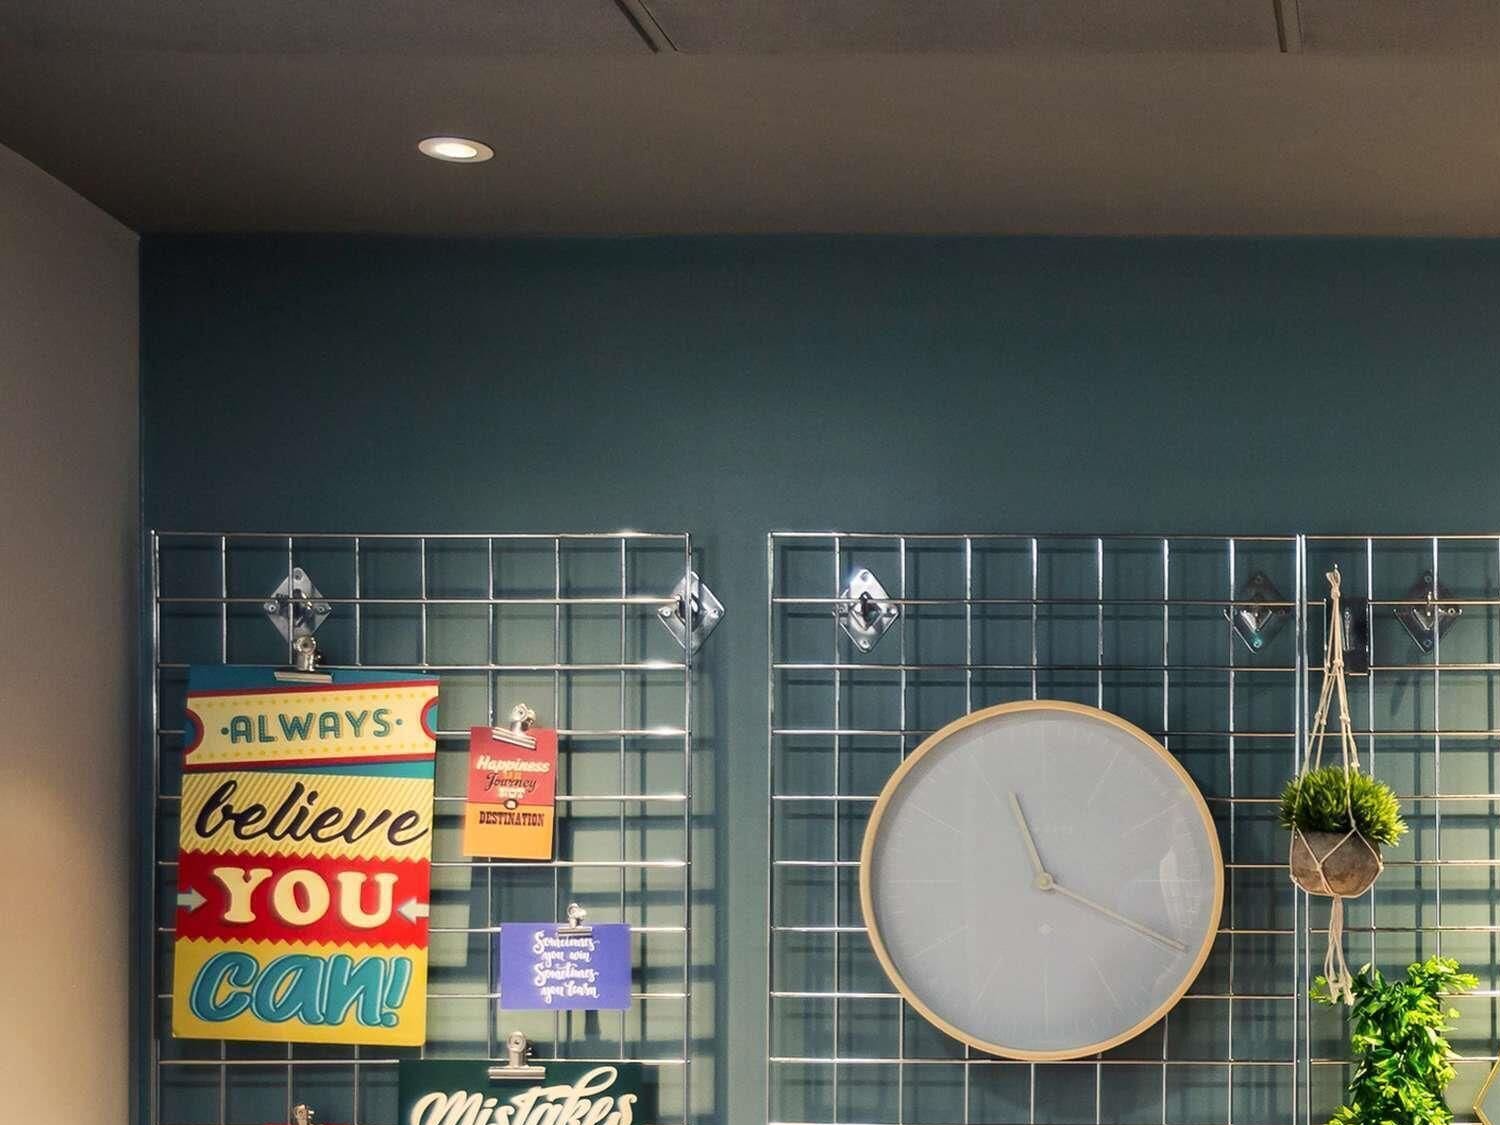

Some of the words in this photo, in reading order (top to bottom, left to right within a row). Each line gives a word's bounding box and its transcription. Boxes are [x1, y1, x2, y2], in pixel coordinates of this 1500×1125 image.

[229, 707, 391, 744] ALWAYS
[476, 754, 551, 774] Happiness
[484, 773, 537, 793] Journey
[195, 779, 430, 846] believe
[479, 811, 545, 827] DESTINATION
[213, 866, 399, 929] YOU
[541, 950, 566, 968] you
[540, 985, 565, 1004] you
